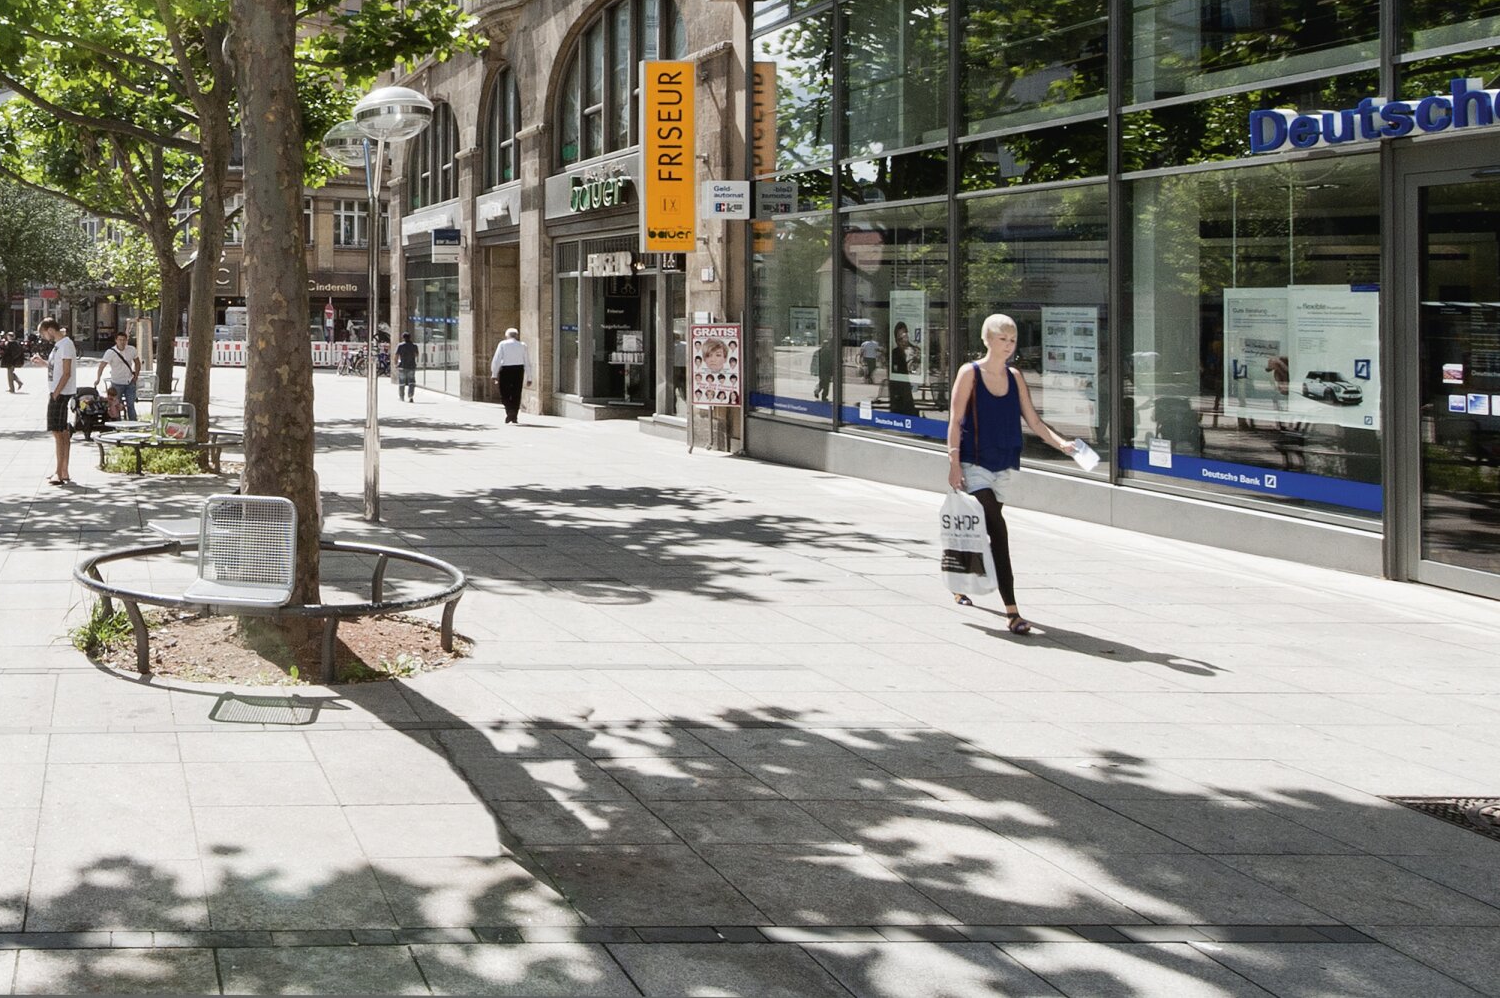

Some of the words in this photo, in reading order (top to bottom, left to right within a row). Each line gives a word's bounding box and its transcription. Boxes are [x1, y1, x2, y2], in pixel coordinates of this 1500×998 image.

[1250, 77, 1500, 154] Deutsch
[657, 71, 683, 182] FRISEUR
[647, 227, 692, 239] bauer
[308, 279, 358, 292] Cinderella
[692, 327, 738, 338] GRATIS!
[1201, 468, 1238, 483] Deutsche
[1239, 474, 1261, 486] Bank
